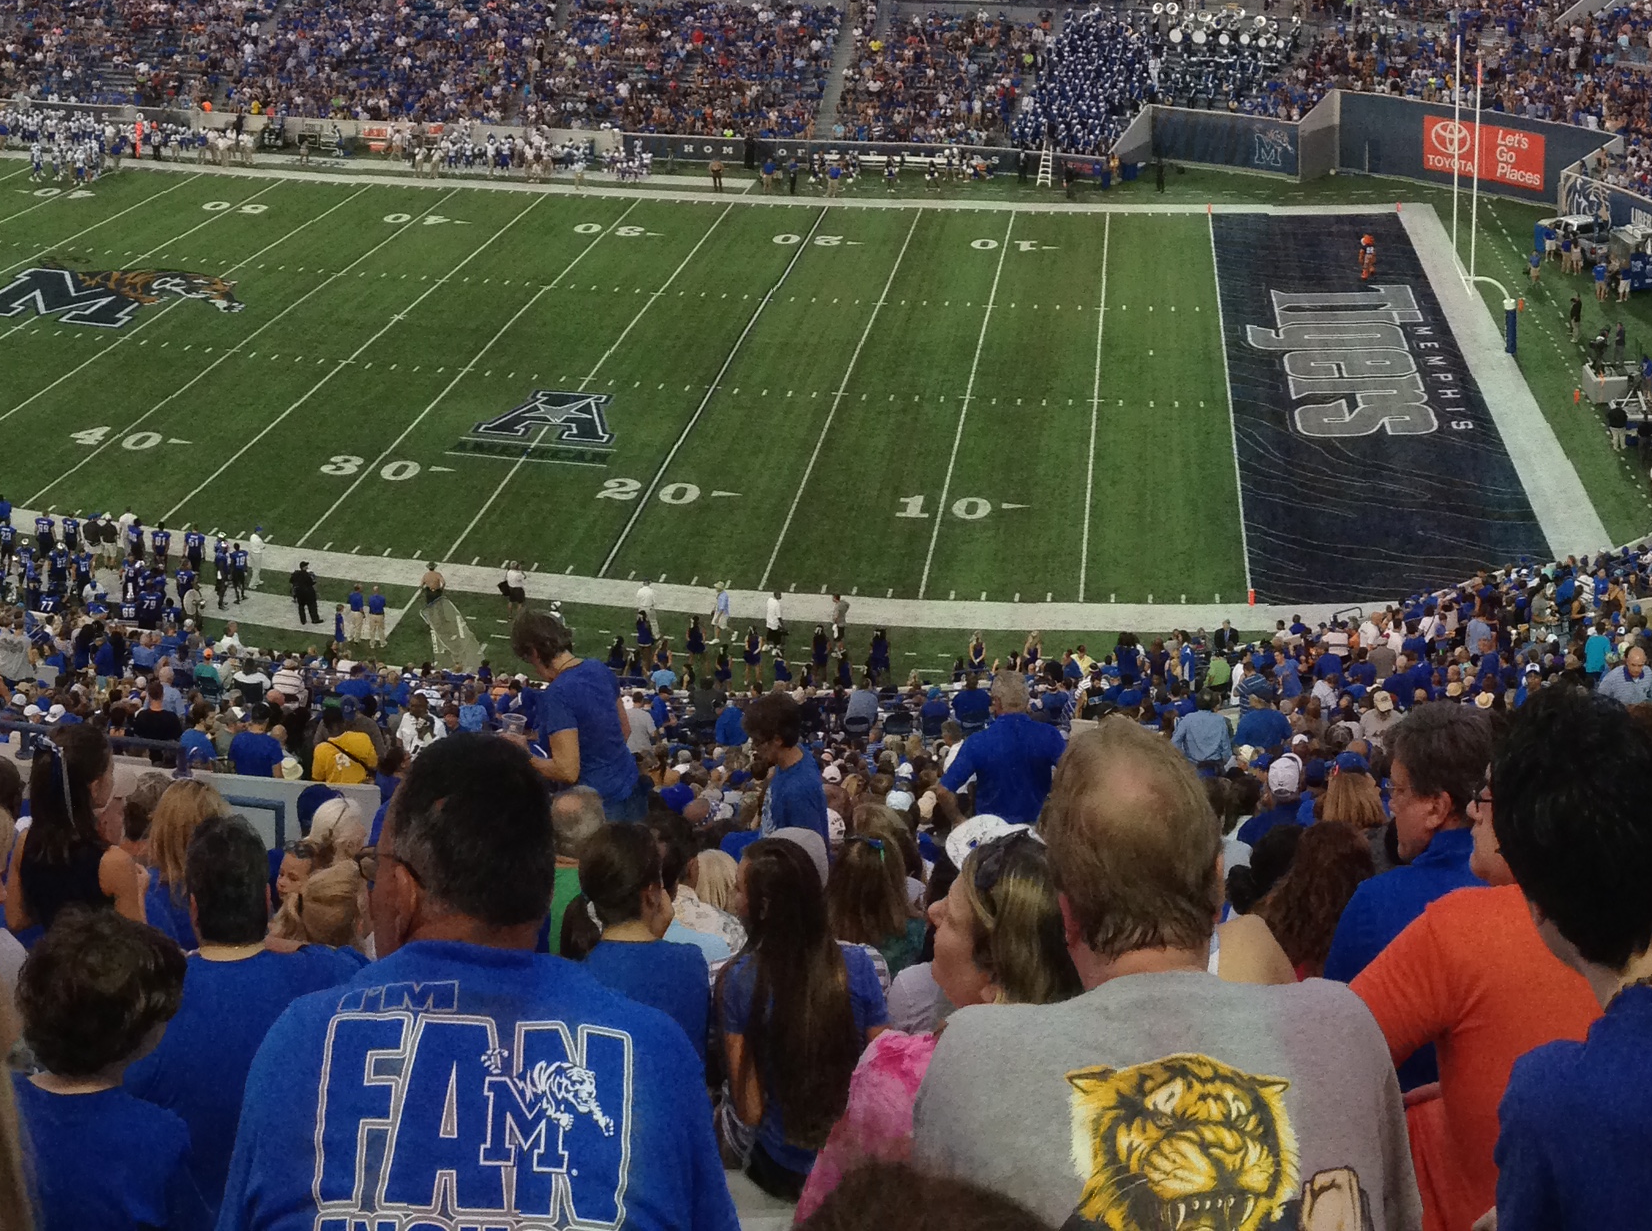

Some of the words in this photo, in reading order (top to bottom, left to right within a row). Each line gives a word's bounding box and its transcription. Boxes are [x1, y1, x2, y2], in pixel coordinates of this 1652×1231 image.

[1497, 130, 1529, 150] Let's
[1427, 154, 1475, 173] TOYOTA
[1496, 148, 1517, 164] Go
[1496, 163, 1541, 186] Places
[1413, 326, 1473, 430] MEMPHIS
[69, 426, 163, 450] 40
[319, 454, 422, 481] 30
[595, 477, 702, 505] 20
[896, 493, 992, 519] 10
[336, 980, 459, 1013] I'M
[311, 1010, 634, 1231] FAN
